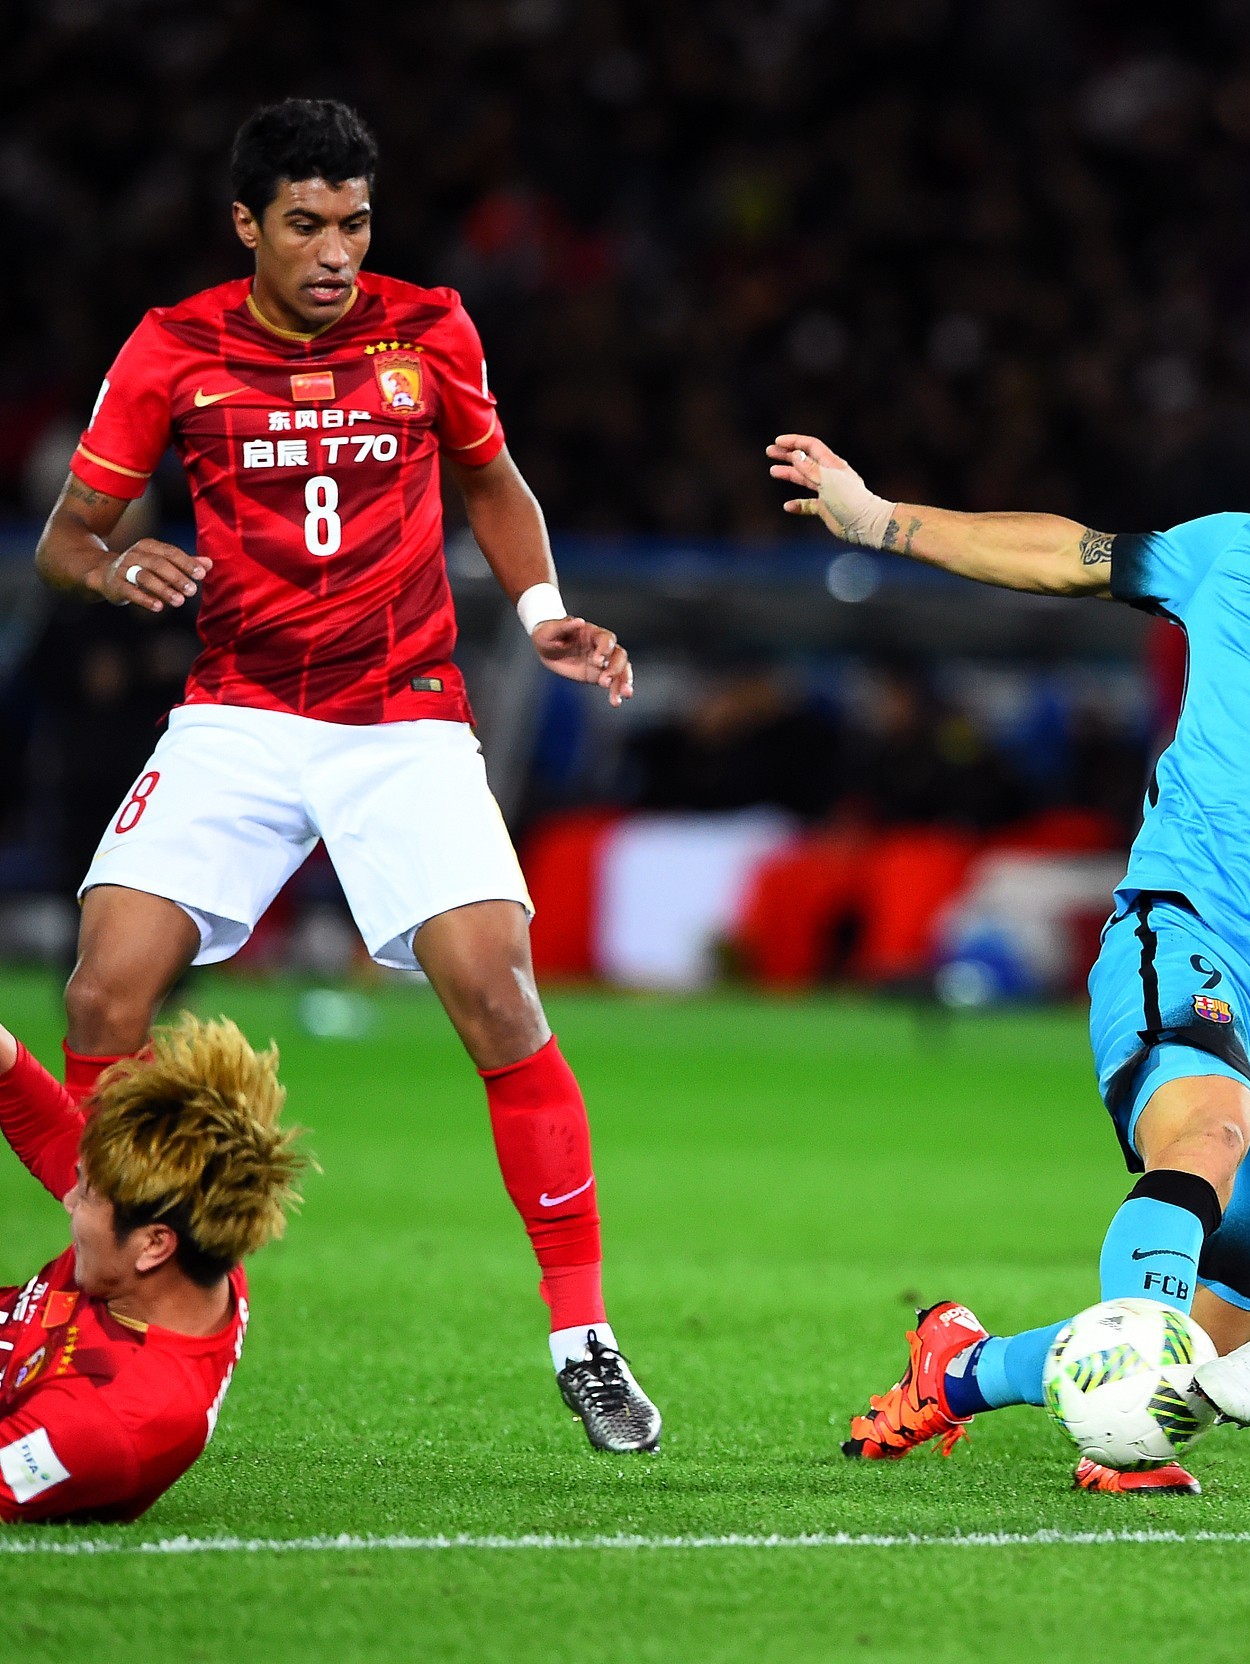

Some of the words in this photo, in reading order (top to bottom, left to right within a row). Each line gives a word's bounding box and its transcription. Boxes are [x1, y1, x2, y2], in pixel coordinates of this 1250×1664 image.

[268, 410, 371, 431] 东风日产
[243, 439, 309, 468] 启辰
[320, 434, 398, 464] T70
[304, 476, 341, 557] 8
[115, 771, 160, 834] 8
[1190, 954, 1222, 989] 9
[1144, 1271, 1189, 1300] FCB
